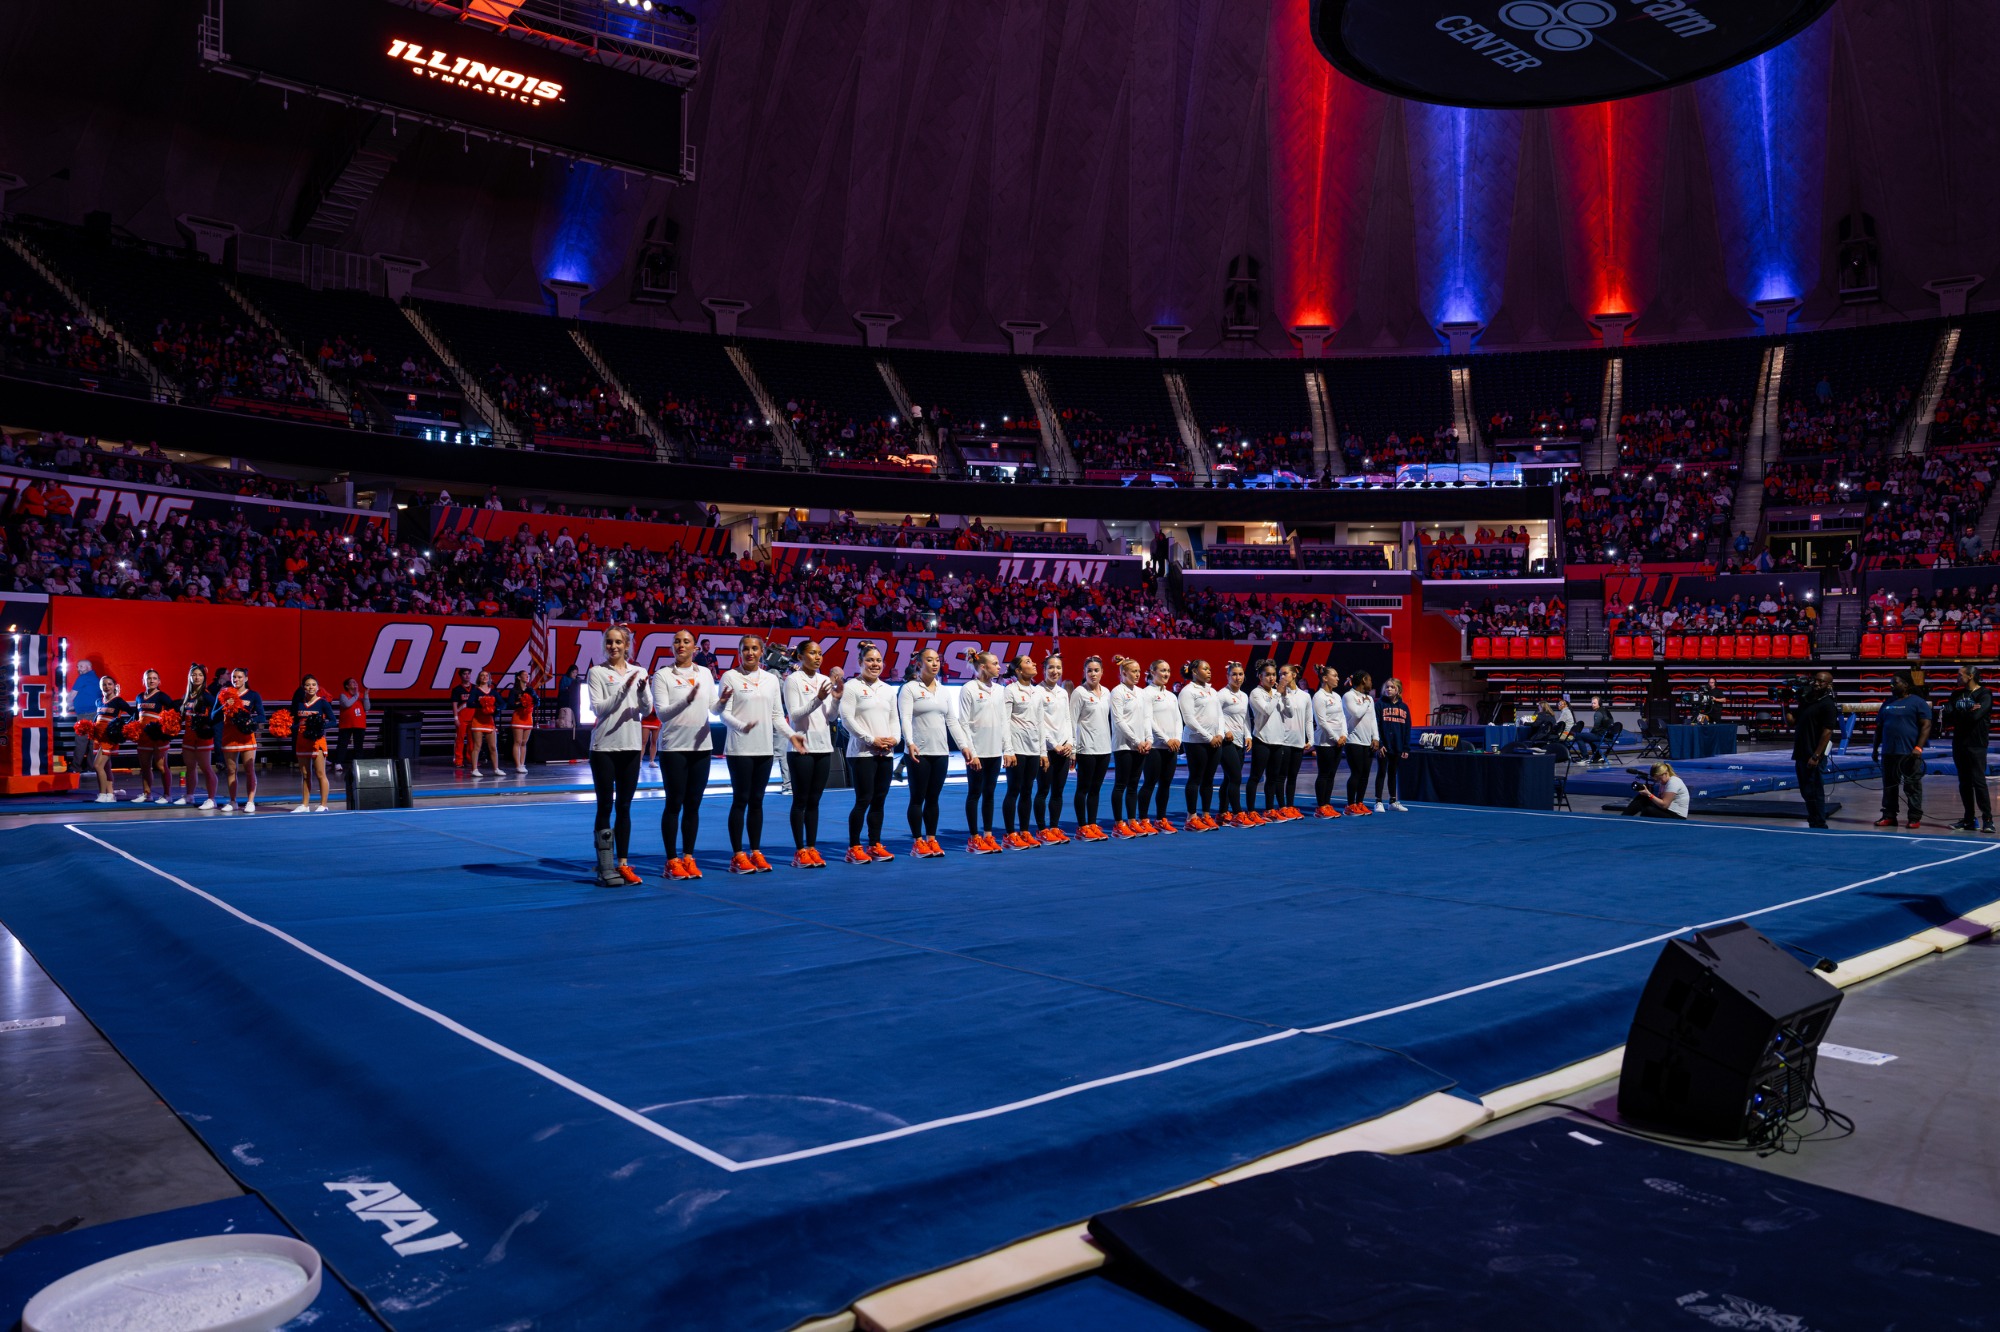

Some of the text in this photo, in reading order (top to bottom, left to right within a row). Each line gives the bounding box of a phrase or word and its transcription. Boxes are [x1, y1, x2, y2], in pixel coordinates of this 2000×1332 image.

[1630, 0, 1717, 38] arm
[1434, 15, 1544, 73] CENTER
[387, 38, 563, 100] ILLINOIS
[412, 66, 541, 106] GYMNASTICS
[0, 474, 195, 530] TING
[267, 505, 281, 514] 110
[997, 559, 1108, 585] ILLINI
[1705, 575, 1717, 583] 115
[323, 1180, 464, 1258] AAI
